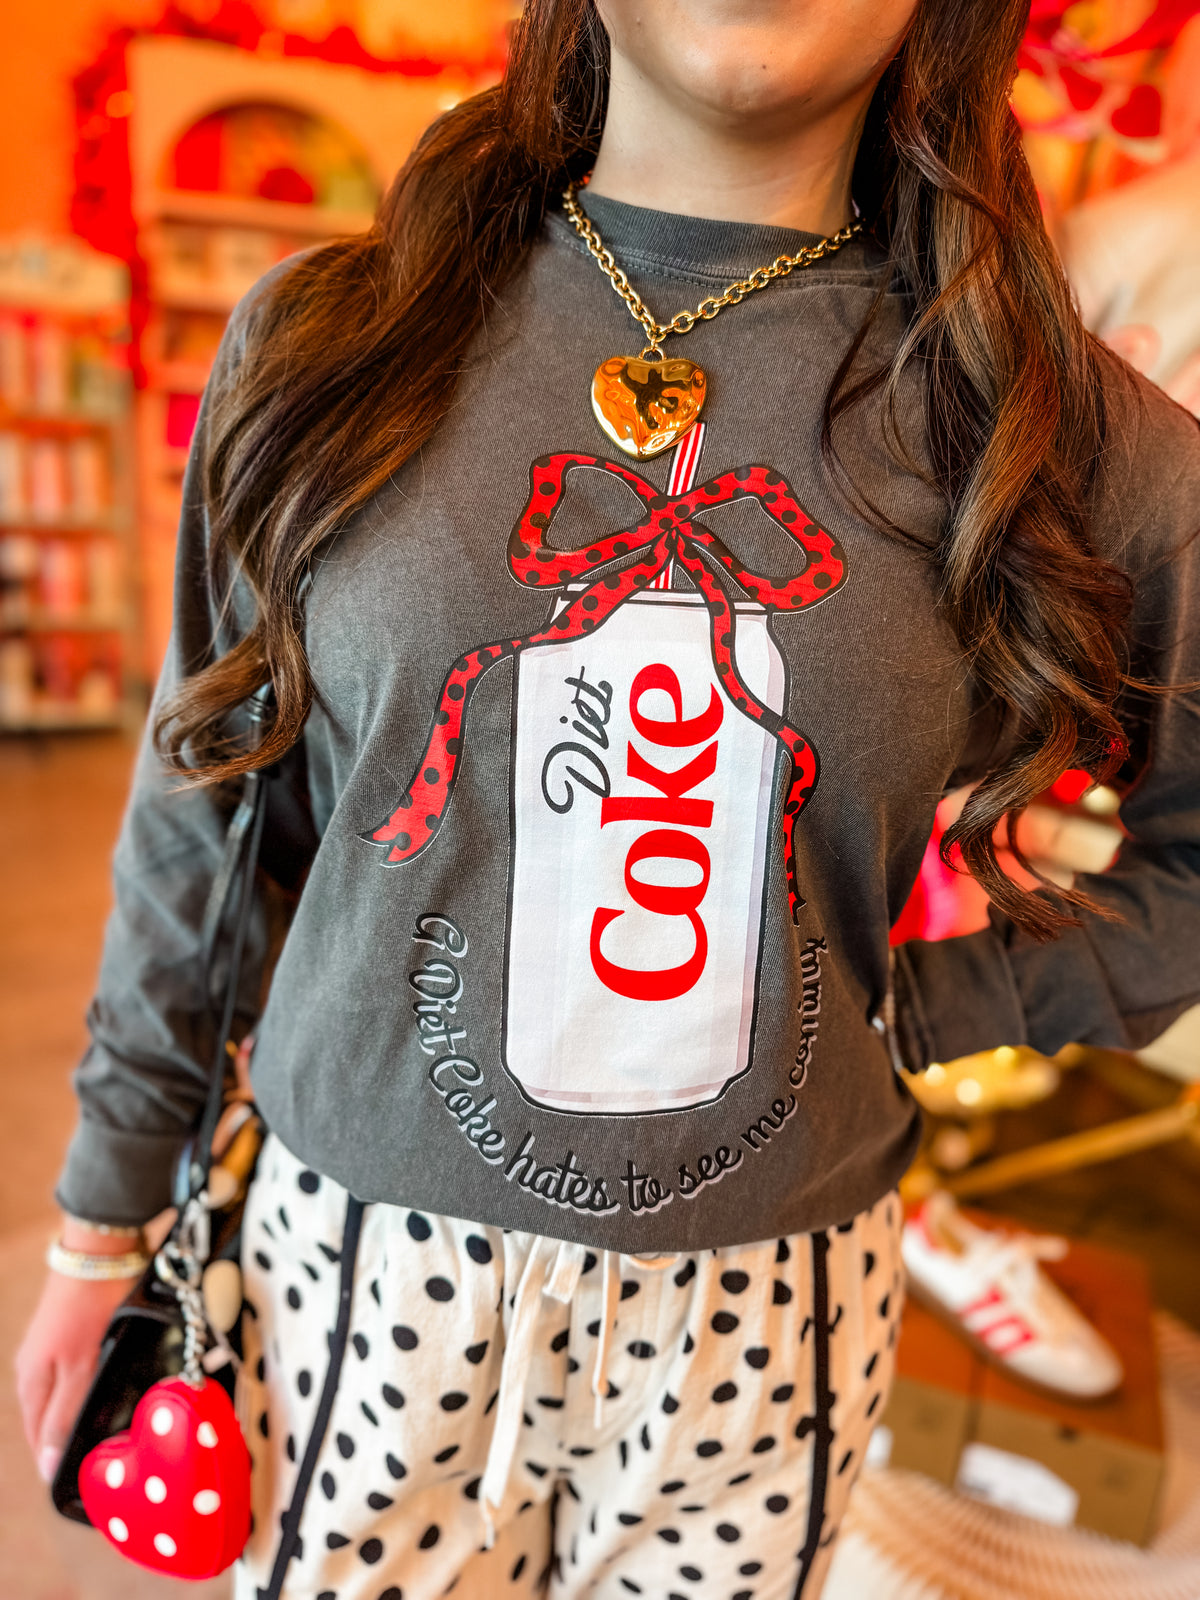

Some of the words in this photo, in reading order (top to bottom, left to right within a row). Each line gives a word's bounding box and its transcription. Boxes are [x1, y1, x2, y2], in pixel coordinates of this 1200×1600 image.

[541, 666, 613, 814] Diet
[589, 663, 724, 1001] Coke
[409, 957, 466, 1056] Diet
[788, 936, 829, 1089] coming
[429, 1054, 505, 1165] Coke
[741, 1093, 800, 1152] me
[504, 1131, 619, 1216] hates
[620, 1159, 674, 1216] to
[678, 1143, 748, 1199] see
